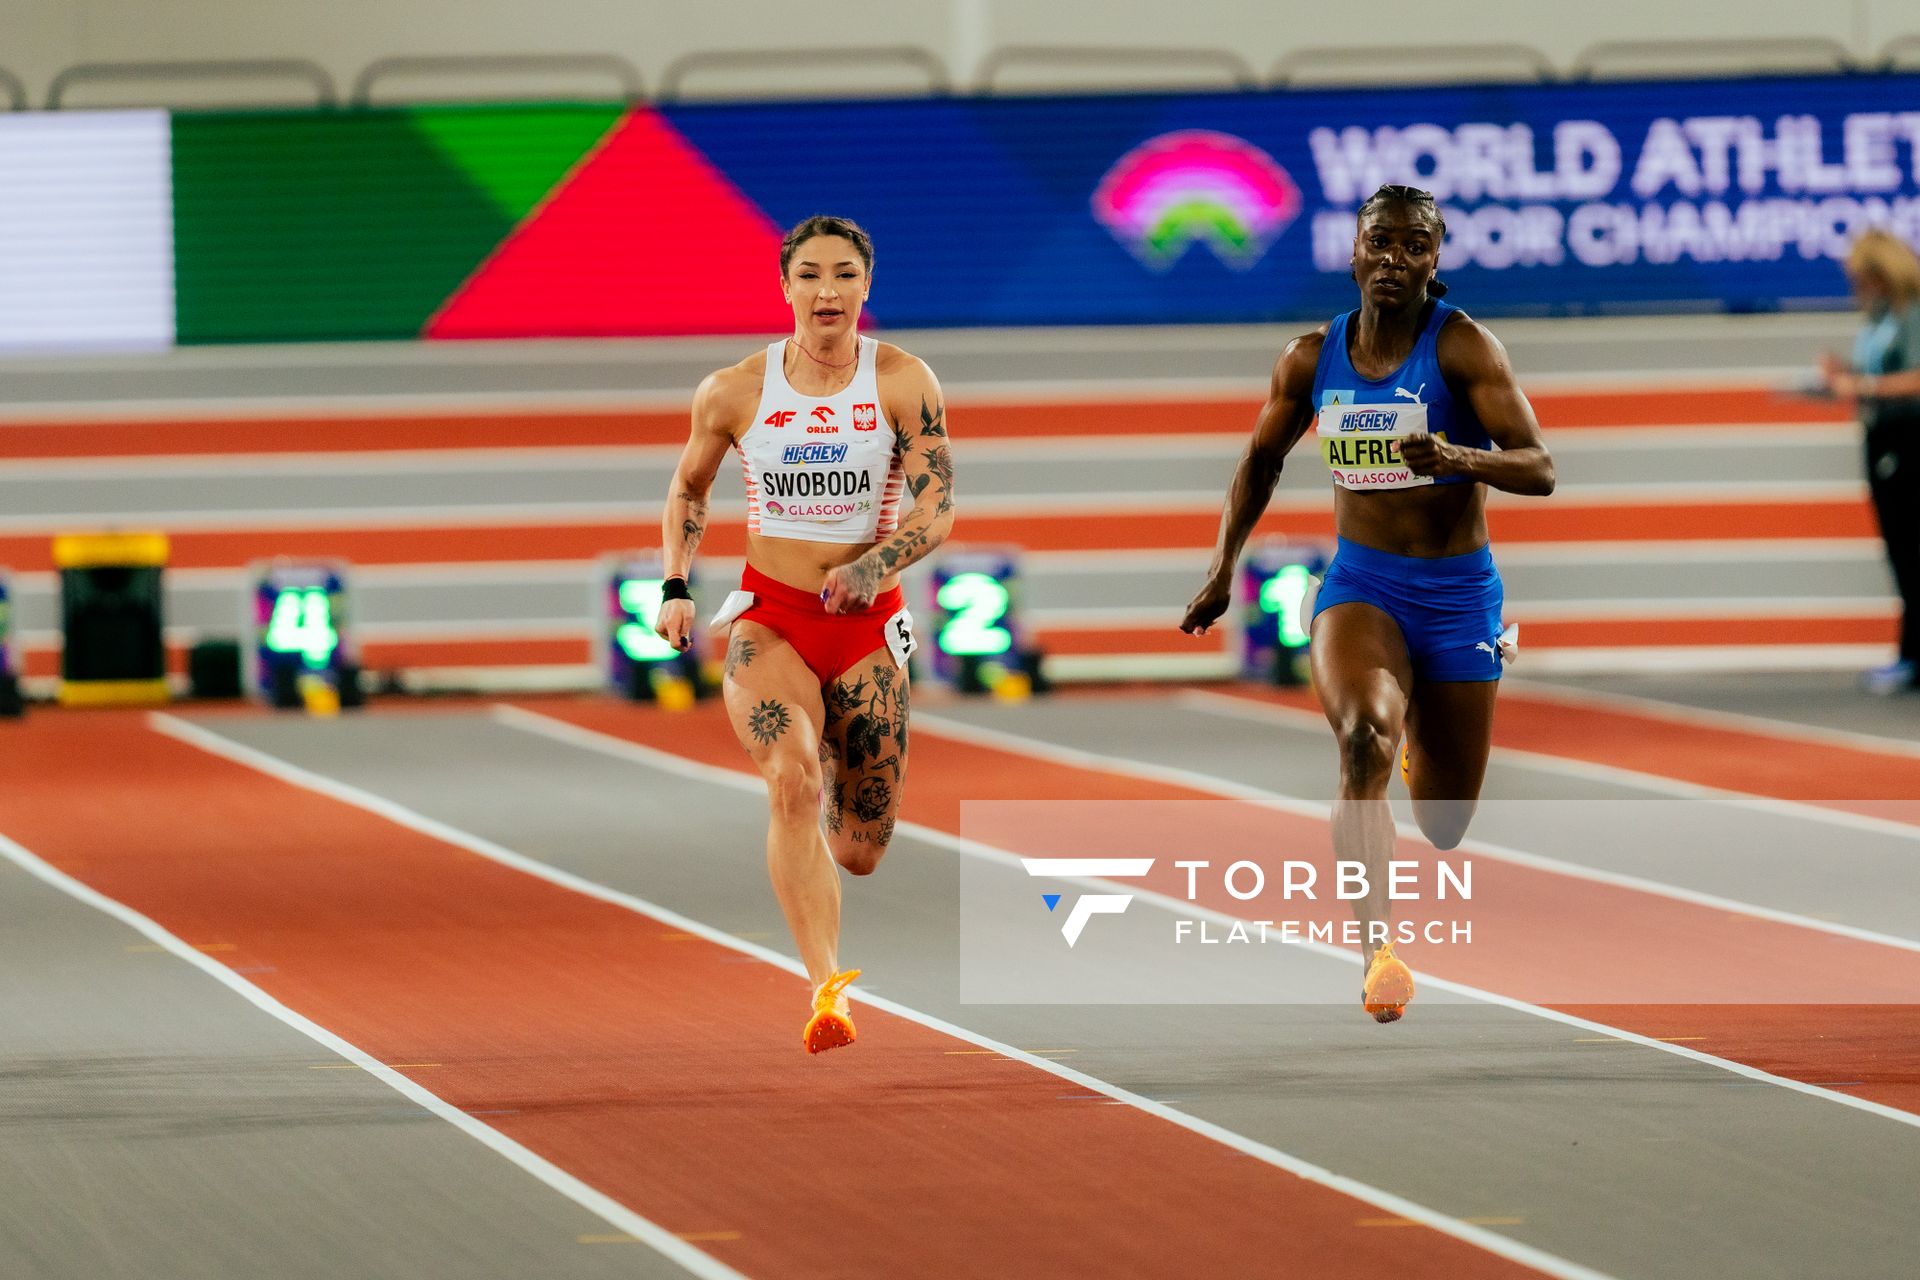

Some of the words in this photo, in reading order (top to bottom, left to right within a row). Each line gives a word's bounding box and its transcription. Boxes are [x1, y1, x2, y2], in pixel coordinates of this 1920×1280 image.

[1309, 120, 1621, 204] WORLD
[764, 411, 797, 428] 4F
[806, 426, 839, 434] ORLEN
[1339, 411, 1398, 431] HI-CHEW
[782, 443, 848, 465] HI-CHEW
[1329, 439, 1402, 465] ALFRE
[762, 469, 872, 497] SWOBODA
[1347, 471, 1409, 484] GLASGOW
[788, 503, 856, 516] GLASGOW
[857, 501, 872, 513] 24
[937, 572, 1012, 656] 2
[1259, 564, 1312, 648] 1
[266, 585, 339, 670] 4
